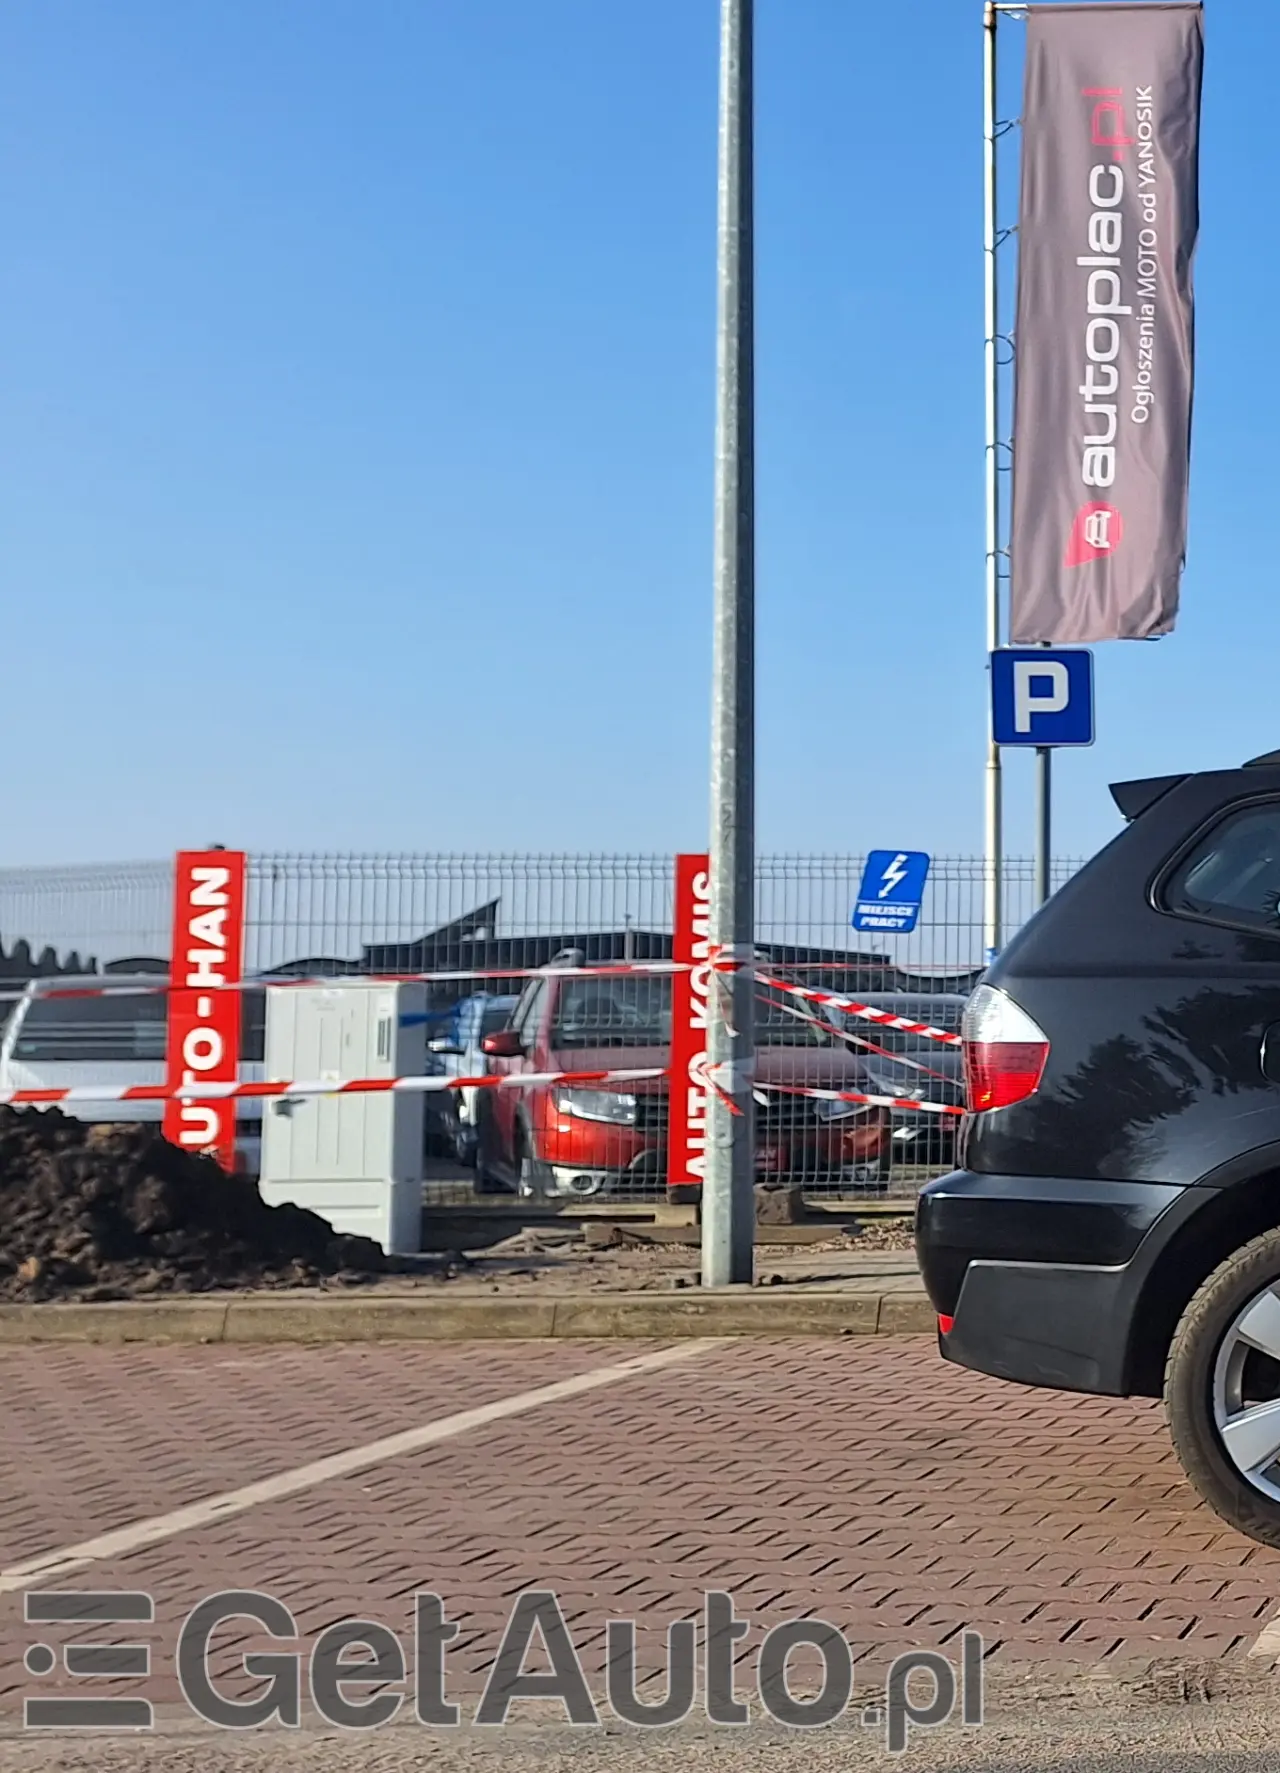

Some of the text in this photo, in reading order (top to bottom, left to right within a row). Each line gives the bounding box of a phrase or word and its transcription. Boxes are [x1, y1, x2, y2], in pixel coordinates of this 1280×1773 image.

[1136, 85, 1157, 191] YANOSIK
[1138, 193, 1157, 224] od
[1076, 87, 1136, 488] autoplac.pl
[1137, 229, 1157, 297] MOTO
[1013, 660, 1070, 733] P
[179, 867, 230, 1158] UO-HAN
